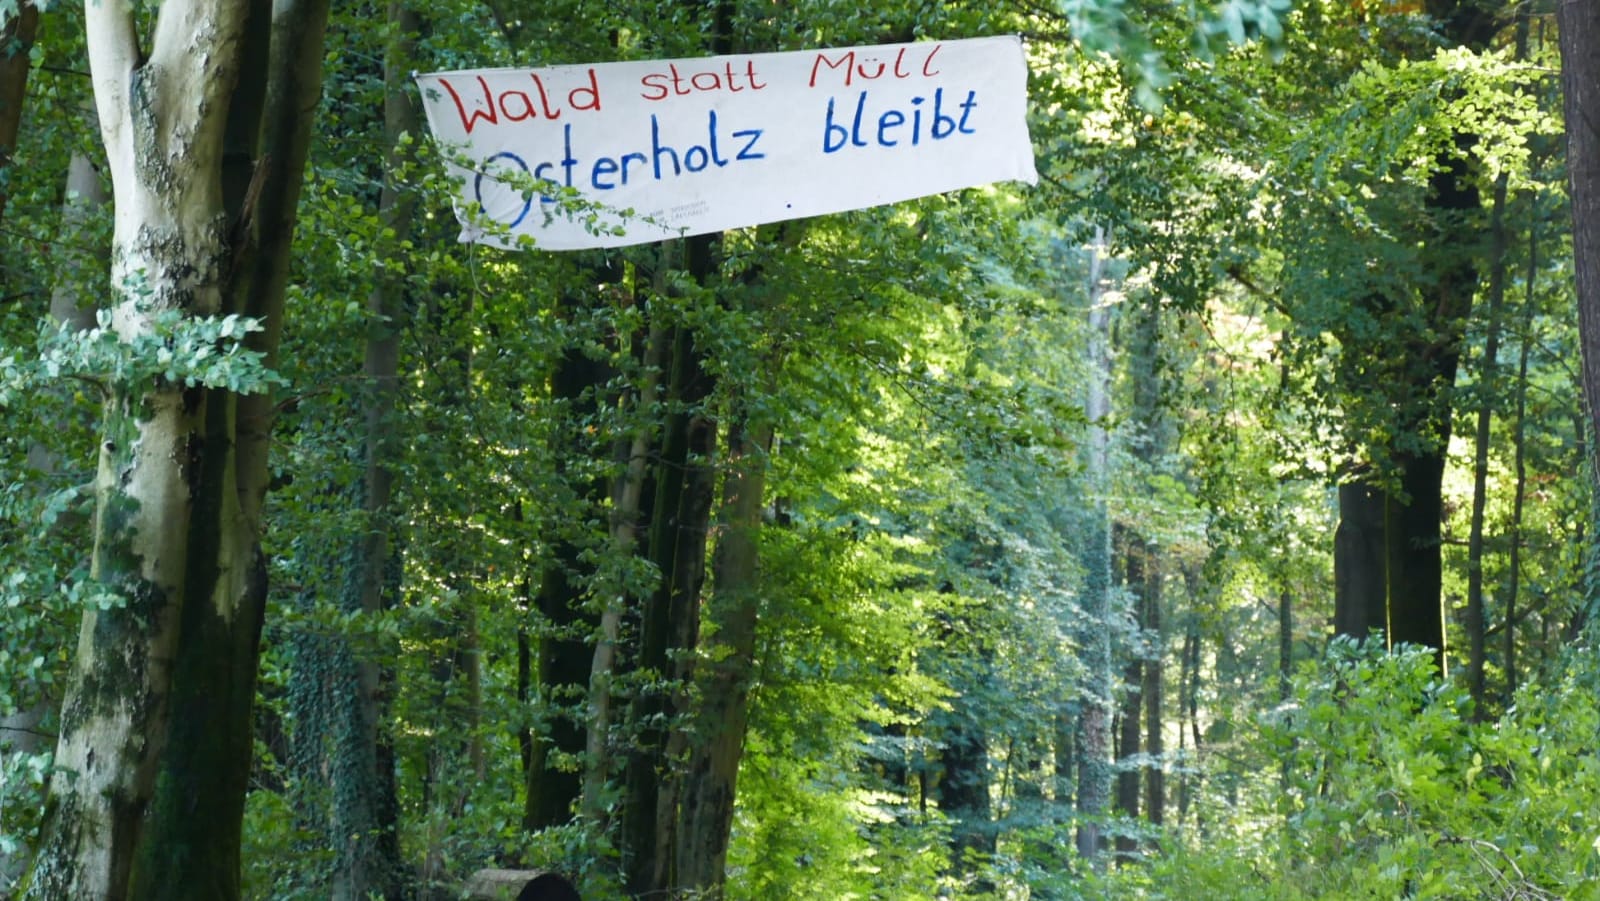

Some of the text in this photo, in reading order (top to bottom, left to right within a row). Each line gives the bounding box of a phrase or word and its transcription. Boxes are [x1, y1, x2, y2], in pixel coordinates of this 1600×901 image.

[440, 44, 942, 133] Wald statt Müll
[474, 87, 978, 229] Osterholz bleibt
